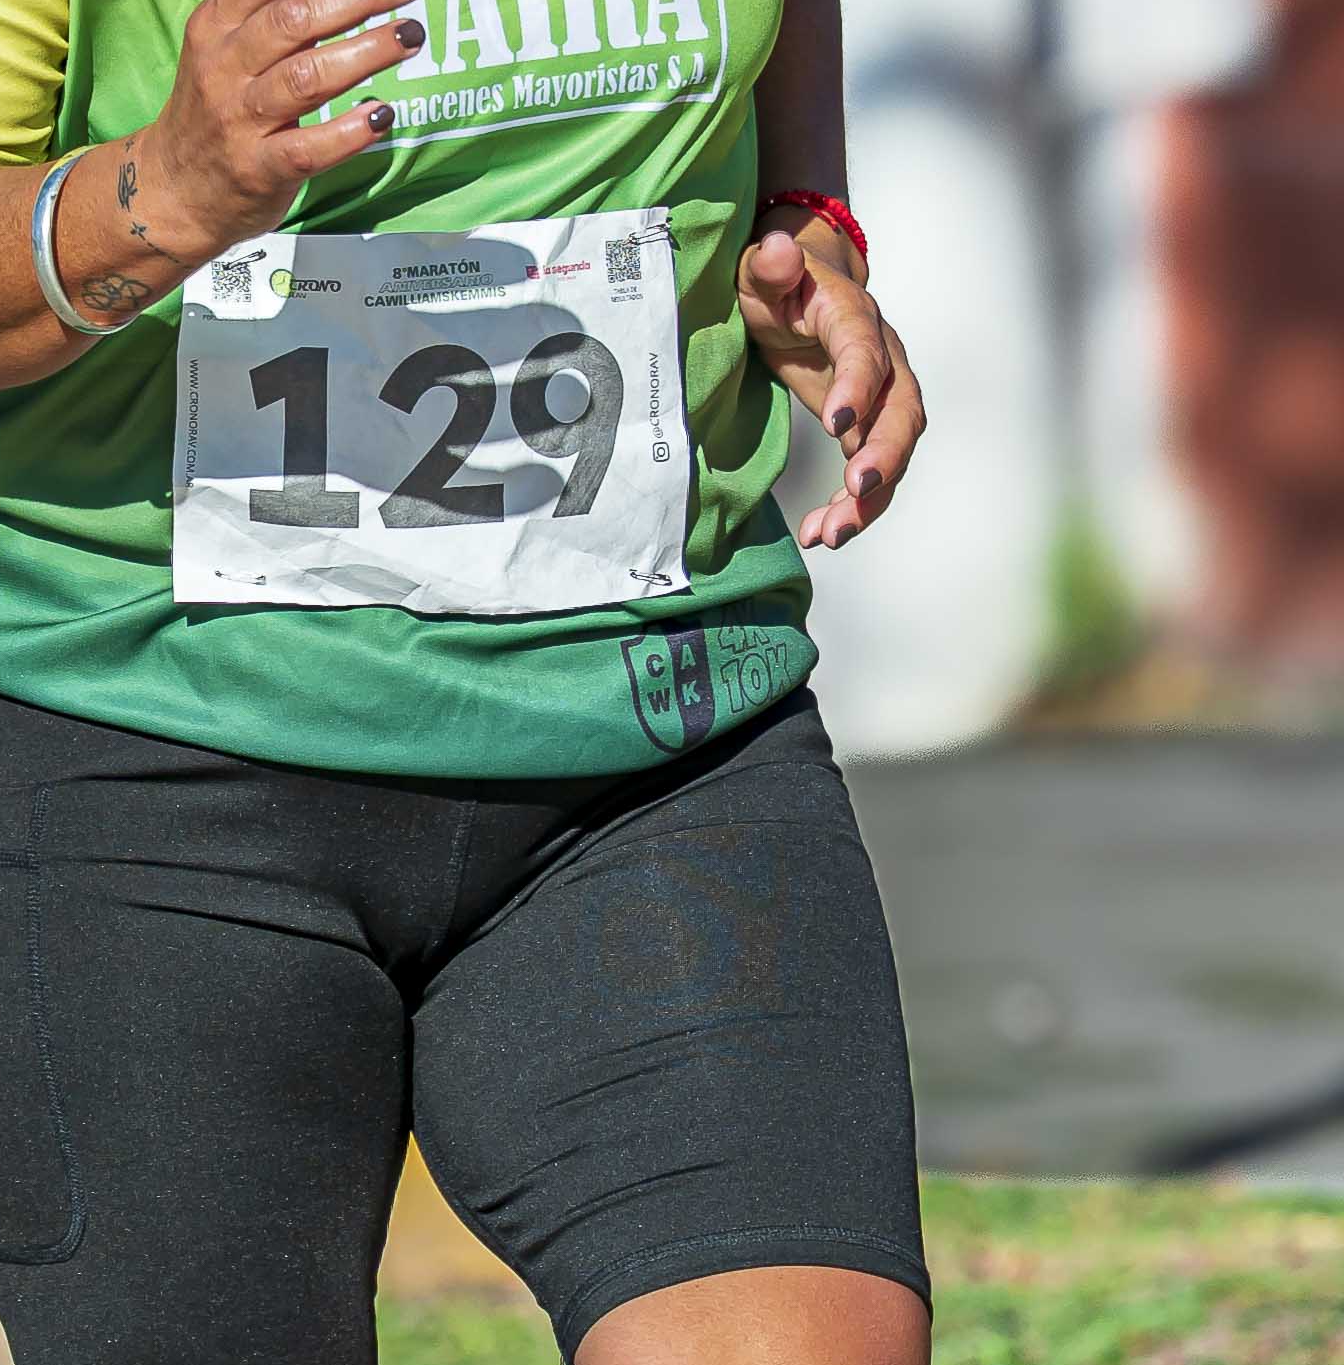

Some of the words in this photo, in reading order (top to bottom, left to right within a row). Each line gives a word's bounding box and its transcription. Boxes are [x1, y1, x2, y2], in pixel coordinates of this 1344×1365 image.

[353, 82, 504, 128] macenes
[512, 62, 658, 110] Mayoristas
[364, 286, 506, 307] CAWILLIAMSKEMMIS
[185, 358, 199, 489] WWW.CRONORAV.COM.AR
[249, 332, 624, 529] 129
[649, 352, 664, 439] @CRONORAV
